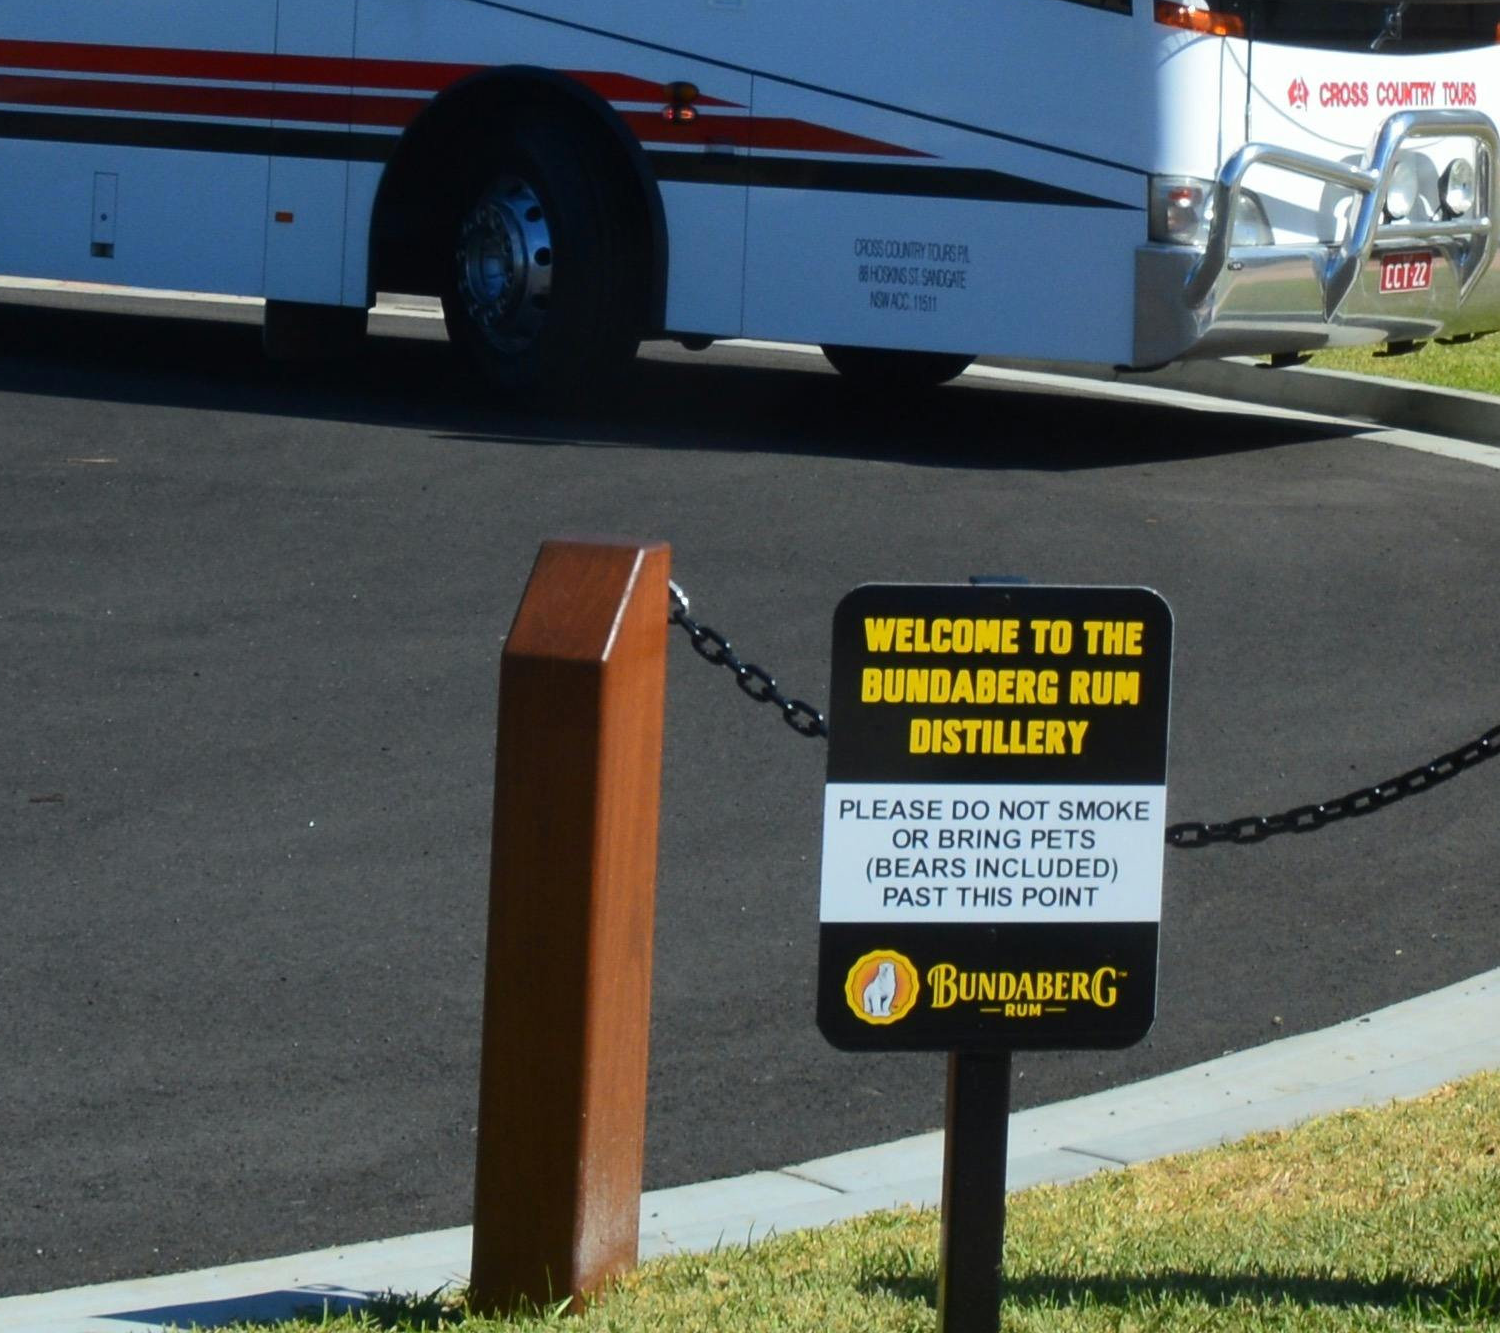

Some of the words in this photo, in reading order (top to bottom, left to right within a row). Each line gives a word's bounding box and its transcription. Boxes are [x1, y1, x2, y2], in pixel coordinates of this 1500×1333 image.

[1319, 81, 1369, 107] CROSS
[1377, 81, 1436, 107] COUNTRY
[1442, 81, 1477, 106] TOURS
[854, 238, 885, 258] CROSS
[885, 239, 926, 261] COUNTRY
[927, 241, 957, 263] TOURS
[922, 267, 967, 290] SANDGATE
[864, 617, 1019, 654] WELCOME
[1031, 620, 1073, 655] TO
[1084, 621, 1144, 656] THE
[861, 668, 1059, 705] BUNDABERG
[1069, 670, 1140, 706] RUM
[909, 718, 1089, 755] DISTILLERY
[839, 799, 943, 821] PLEASE
[951, 799, 990, 822] DO
[998, 799, 1051, 822] NOT
[1058, 800, 1151, 822] SMOKE
[892, 828, 929, 850] OR
[938, 829, 1023, 850] BRING
[1031, 829, 1096, 851] PETS
[866, 858, 967, 881] (BEARS
[975, 858, 1119, 882] INCLUDED)
[882, 886, 948, 908] PAST
[957, 886, 1012, 908] THIS
[1021, 887, 1099, 908] POINT
[927, 963, 1117, 1009] BUNDABERG
[1004, 1002, 1043, 1018] RUM
